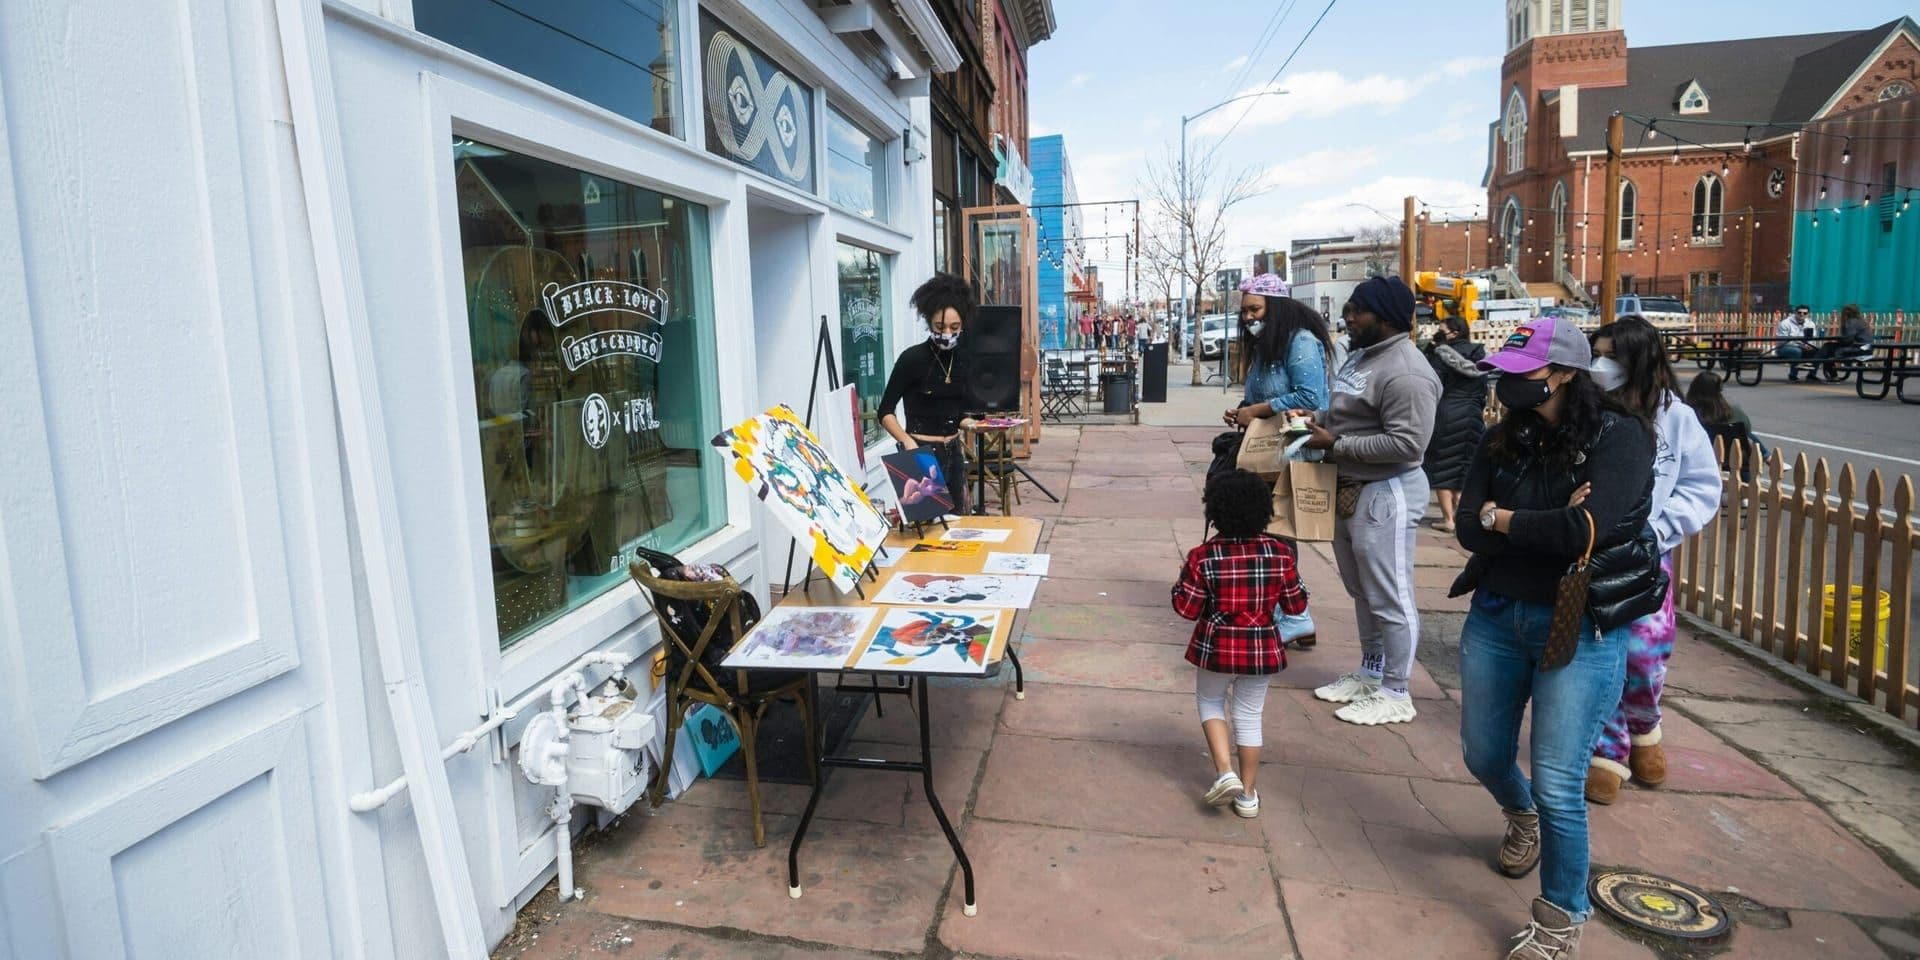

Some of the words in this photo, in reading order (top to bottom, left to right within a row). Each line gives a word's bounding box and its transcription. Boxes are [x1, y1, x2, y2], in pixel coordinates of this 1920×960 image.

[561, 286, 613, 317] BLACK
[624, 289, 657, 314] LOVE
[572, 337, 598, 362] ART
[609, 334, 657, 356] CRYPTO
